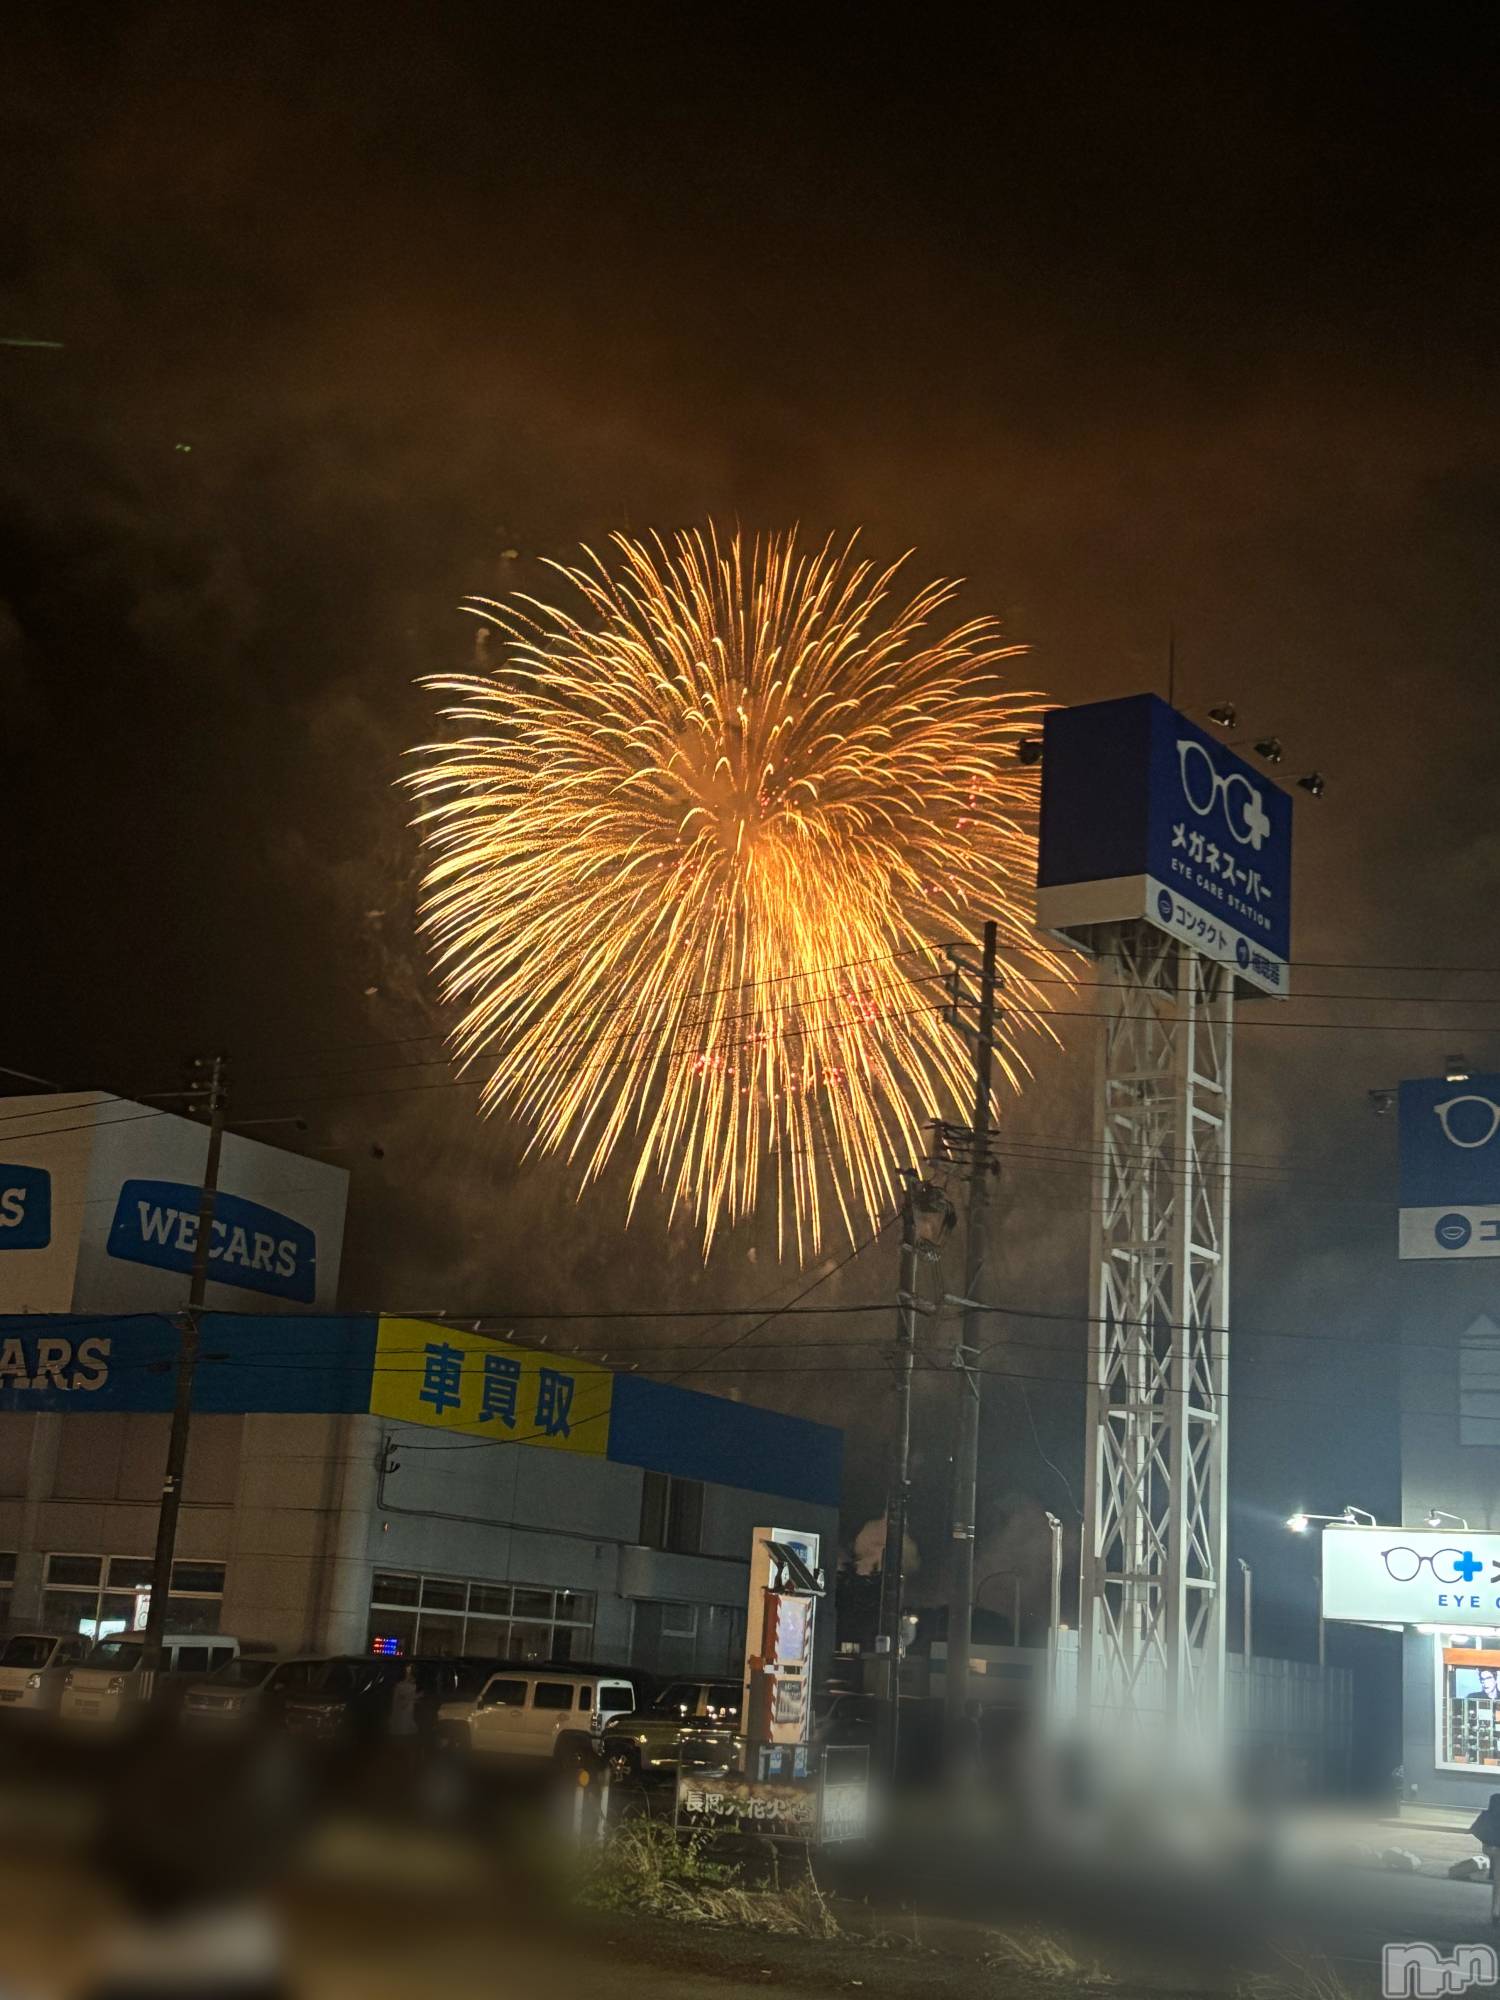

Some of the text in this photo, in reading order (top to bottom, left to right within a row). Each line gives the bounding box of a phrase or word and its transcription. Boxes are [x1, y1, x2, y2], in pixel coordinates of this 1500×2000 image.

[1171, 822, 1272, 903] メガネスーパー
[1171, 857, 1192, 880] EYE
[1196, 873, 1223, 900] CARE
[1175, 904, 1228, 950] コンタクト
[137, 1200, 297, 1278] WECARS
[0, 1337, 112, 1391] ARS
[419, 1342, 575, 1438] 車買取
[1438, 1594, 1480, 1608] EYE
